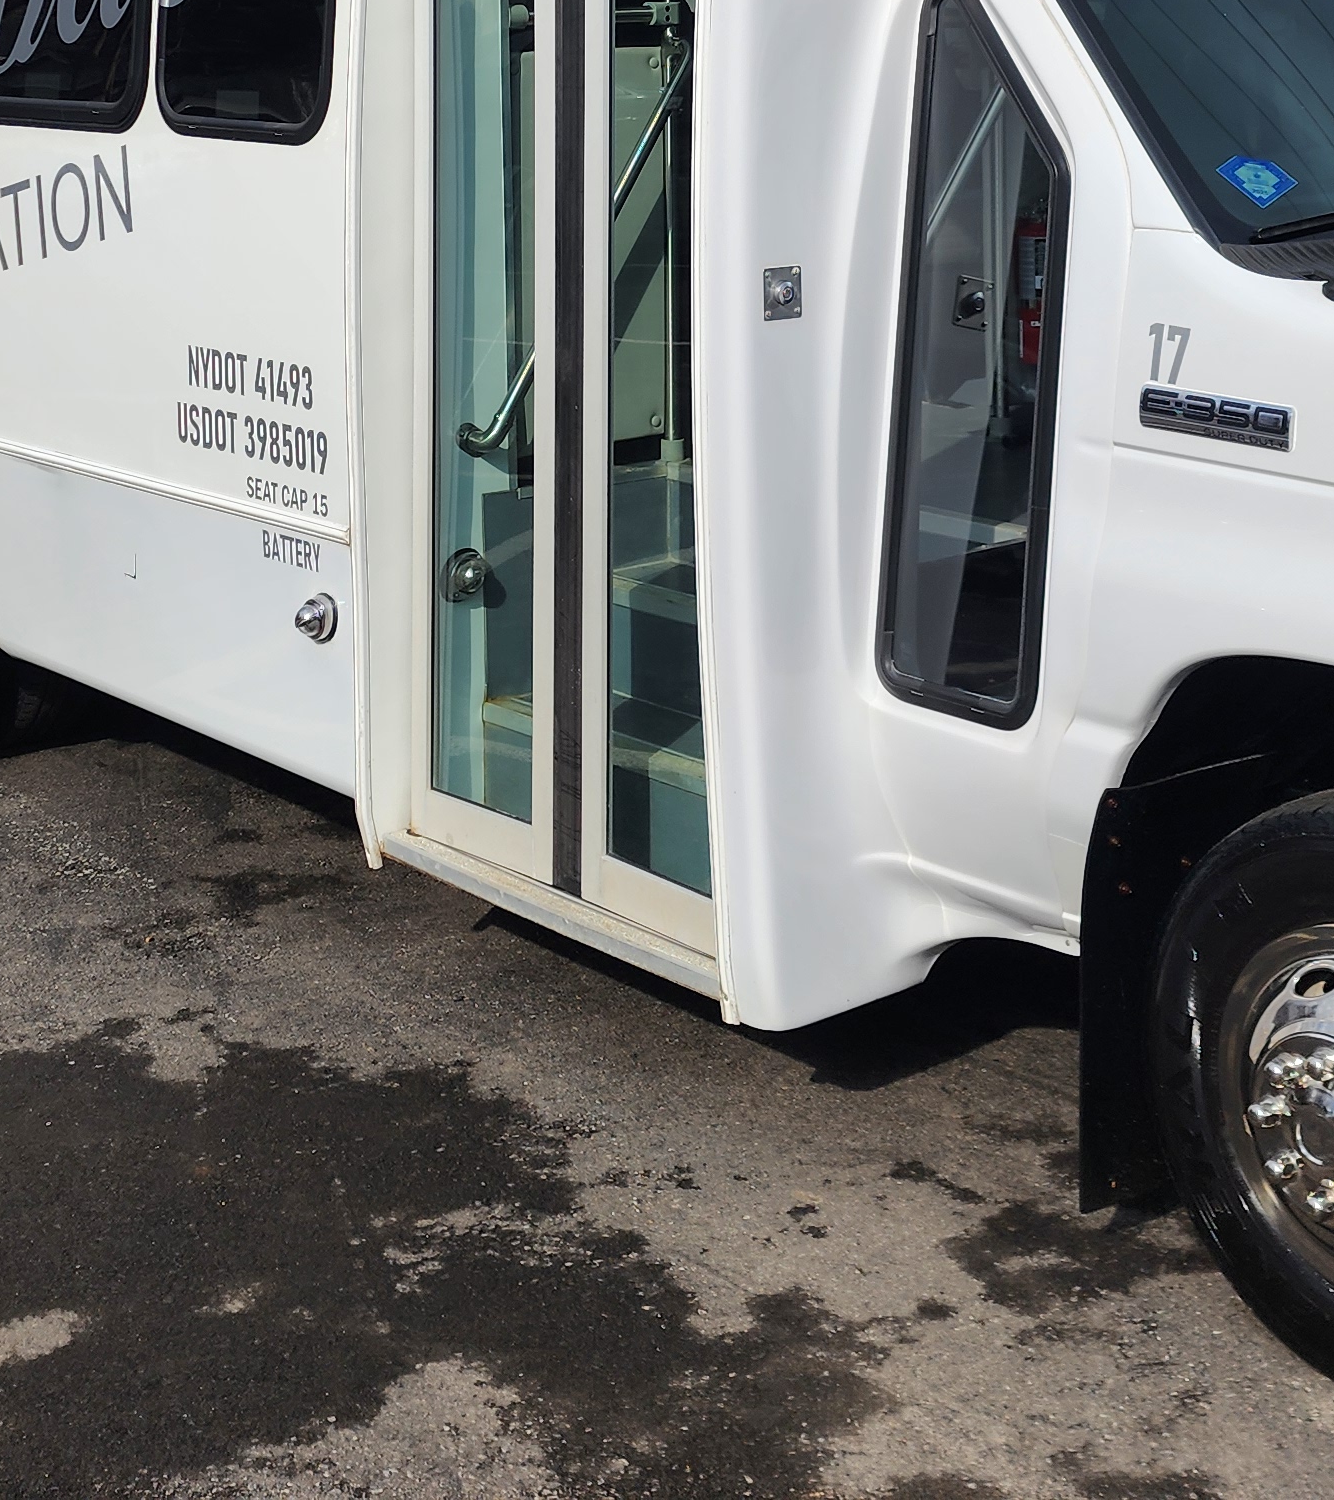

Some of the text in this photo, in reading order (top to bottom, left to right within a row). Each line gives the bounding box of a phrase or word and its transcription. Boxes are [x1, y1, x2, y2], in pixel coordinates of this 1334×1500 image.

[187, 344, 313, 410] NYDOT 41493
[1148, 322, 1192, 386] 17
[177, 401, 328, 476] USDOT 3985019
[246, 476, 328, 518] SEAT CAP 15
[262, 529, 321, 573] BATTERY
